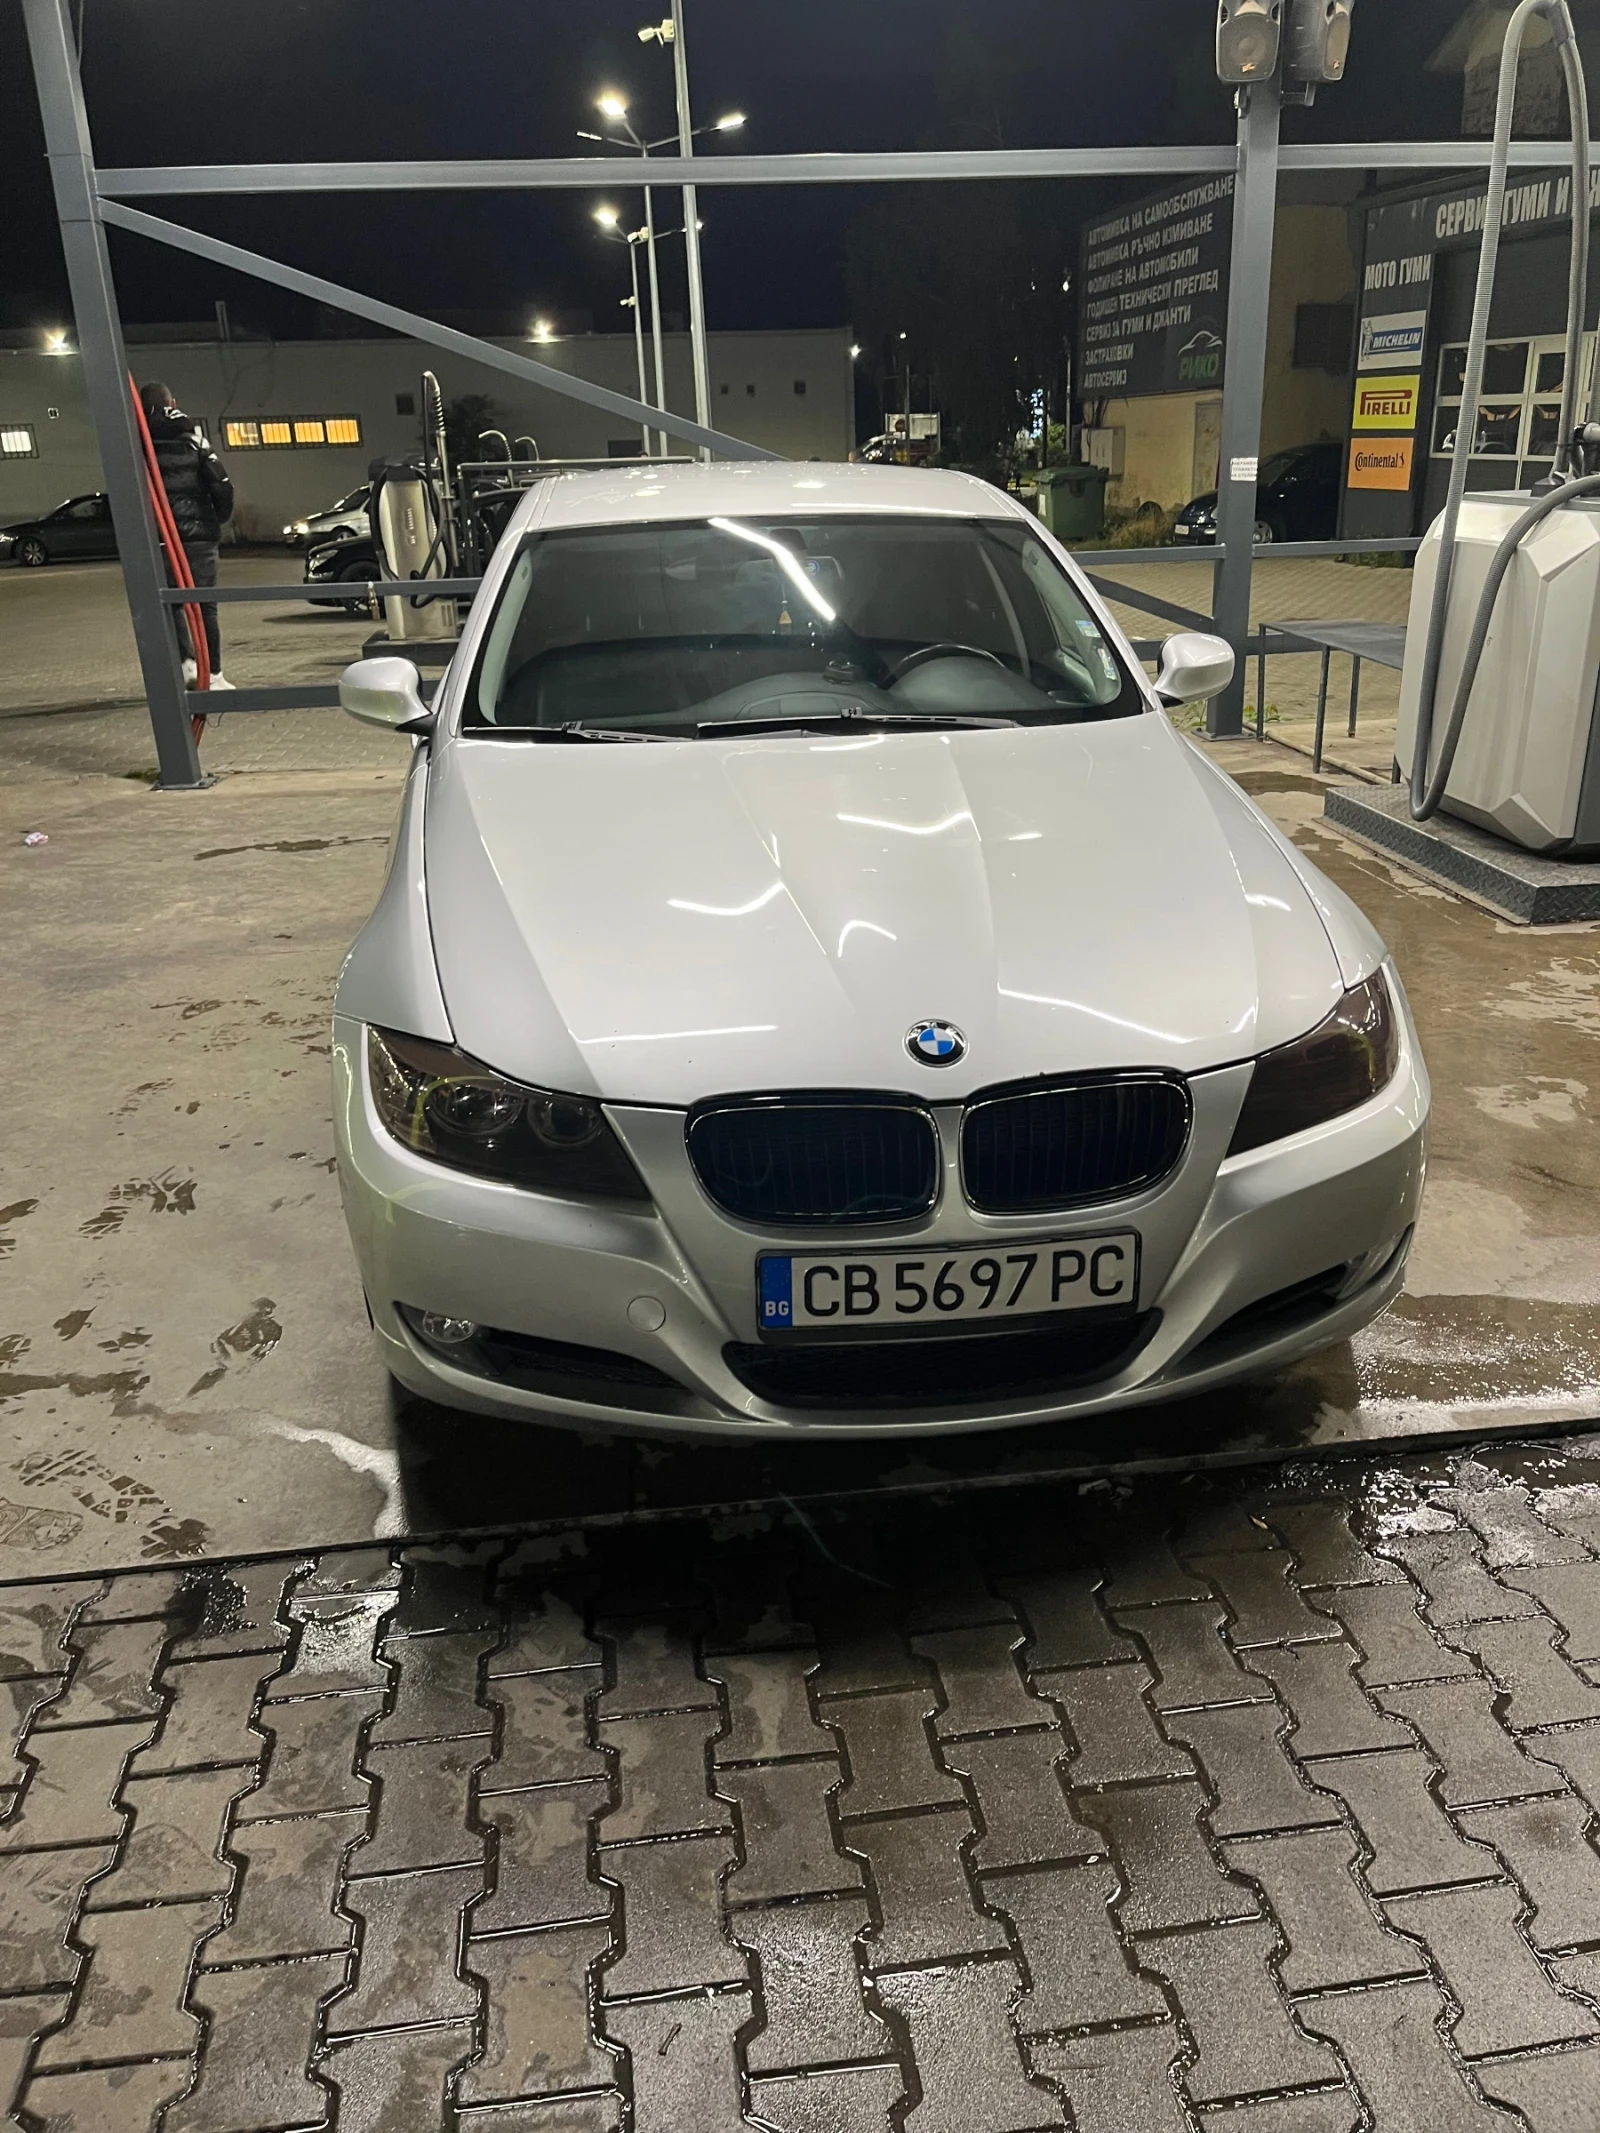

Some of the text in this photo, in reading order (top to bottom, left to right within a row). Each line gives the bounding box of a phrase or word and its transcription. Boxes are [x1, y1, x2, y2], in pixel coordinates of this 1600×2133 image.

[1132, 211, 1143, 230] НА
[1145, 174, 1234, 225] САМООБСЛУЖВАНЕ
[1436, 194, 1488, 239] СЕРВИ
[1501, 180, 1551, 226] ГУМИ
[1554, 176, 1570, 215] И
[1131, 231, 1161, 257] РЪЧНО
[1162, 212, 1213, 246] ИЗМИВАНЕ
[1125, 265, 1137, 284] НА
[1139, 246, 1199, 280] АВТОМОБИЛИ
[1364, 253, 1431, 290] МОТО ГУМИ
[1120, 281, 1171, 311] ТЕХНИЧЕСКИ
[1174, 269, 1219, 297] ПРЕГЛЕД
[1087, 323, 1111, 342] СЕРВИЗ
[1122, 315, 1144, 335] ГУМИ
[1145, 313, 1151, 331] И
[1152, 305, 1191, 332] ДЖАНТИ
[1373, 332, 1421, 348] MICHELIN
[1085, 343, 1134, 366] ЗАСТРАХОВКИ
[1179, 353, 1219, 380] РИКО
[1084, 369, 1127, 388] АВТОСЕРВИЗ
[1360, 390, 1412, 415] PIRELLI
[1355, 451, 1398, 472] Continental
[804, 1244, 1125, 1317] CB 5697 PC
[765, 1301, 789, 1317] BG
